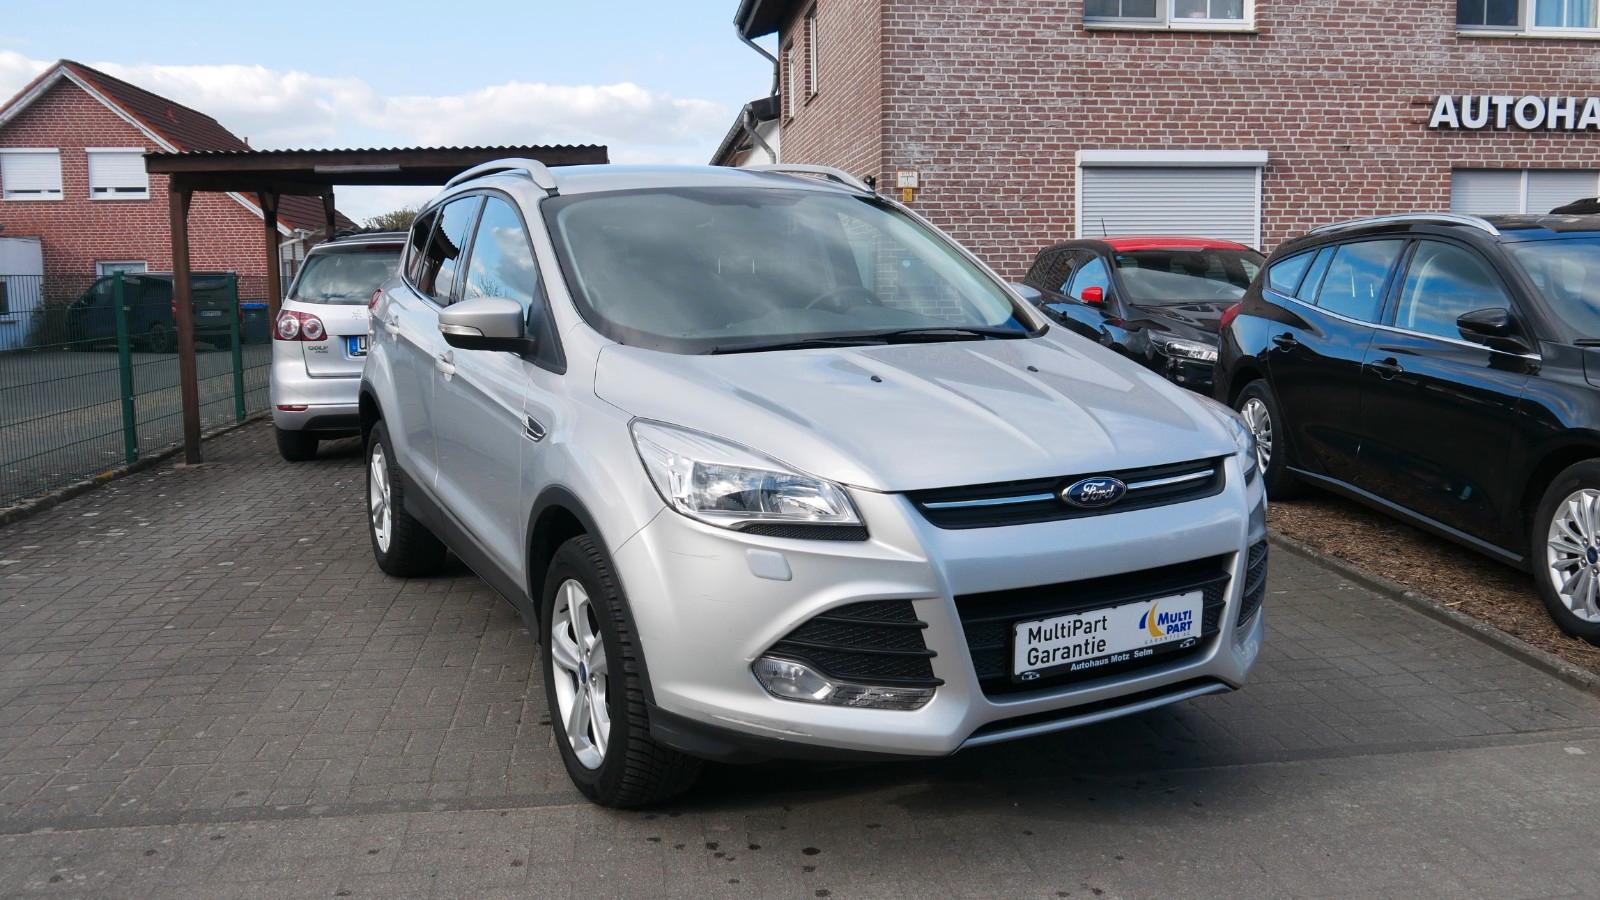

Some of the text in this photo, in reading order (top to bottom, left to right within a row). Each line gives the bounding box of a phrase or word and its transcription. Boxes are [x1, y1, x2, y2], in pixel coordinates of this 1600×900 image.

[1081, 481, 1115, 502] Ford
[1157, 610, 1193, 626] MULTI
[1166, 620, 1193, 635] PART
[1028, 615, 1108, 645] MultiPart
[1027, 638, 1107, 667] Garantie
[1070, 658, 1109, 672] Autohaus
[1111, 653, 1130, 664] Motz
